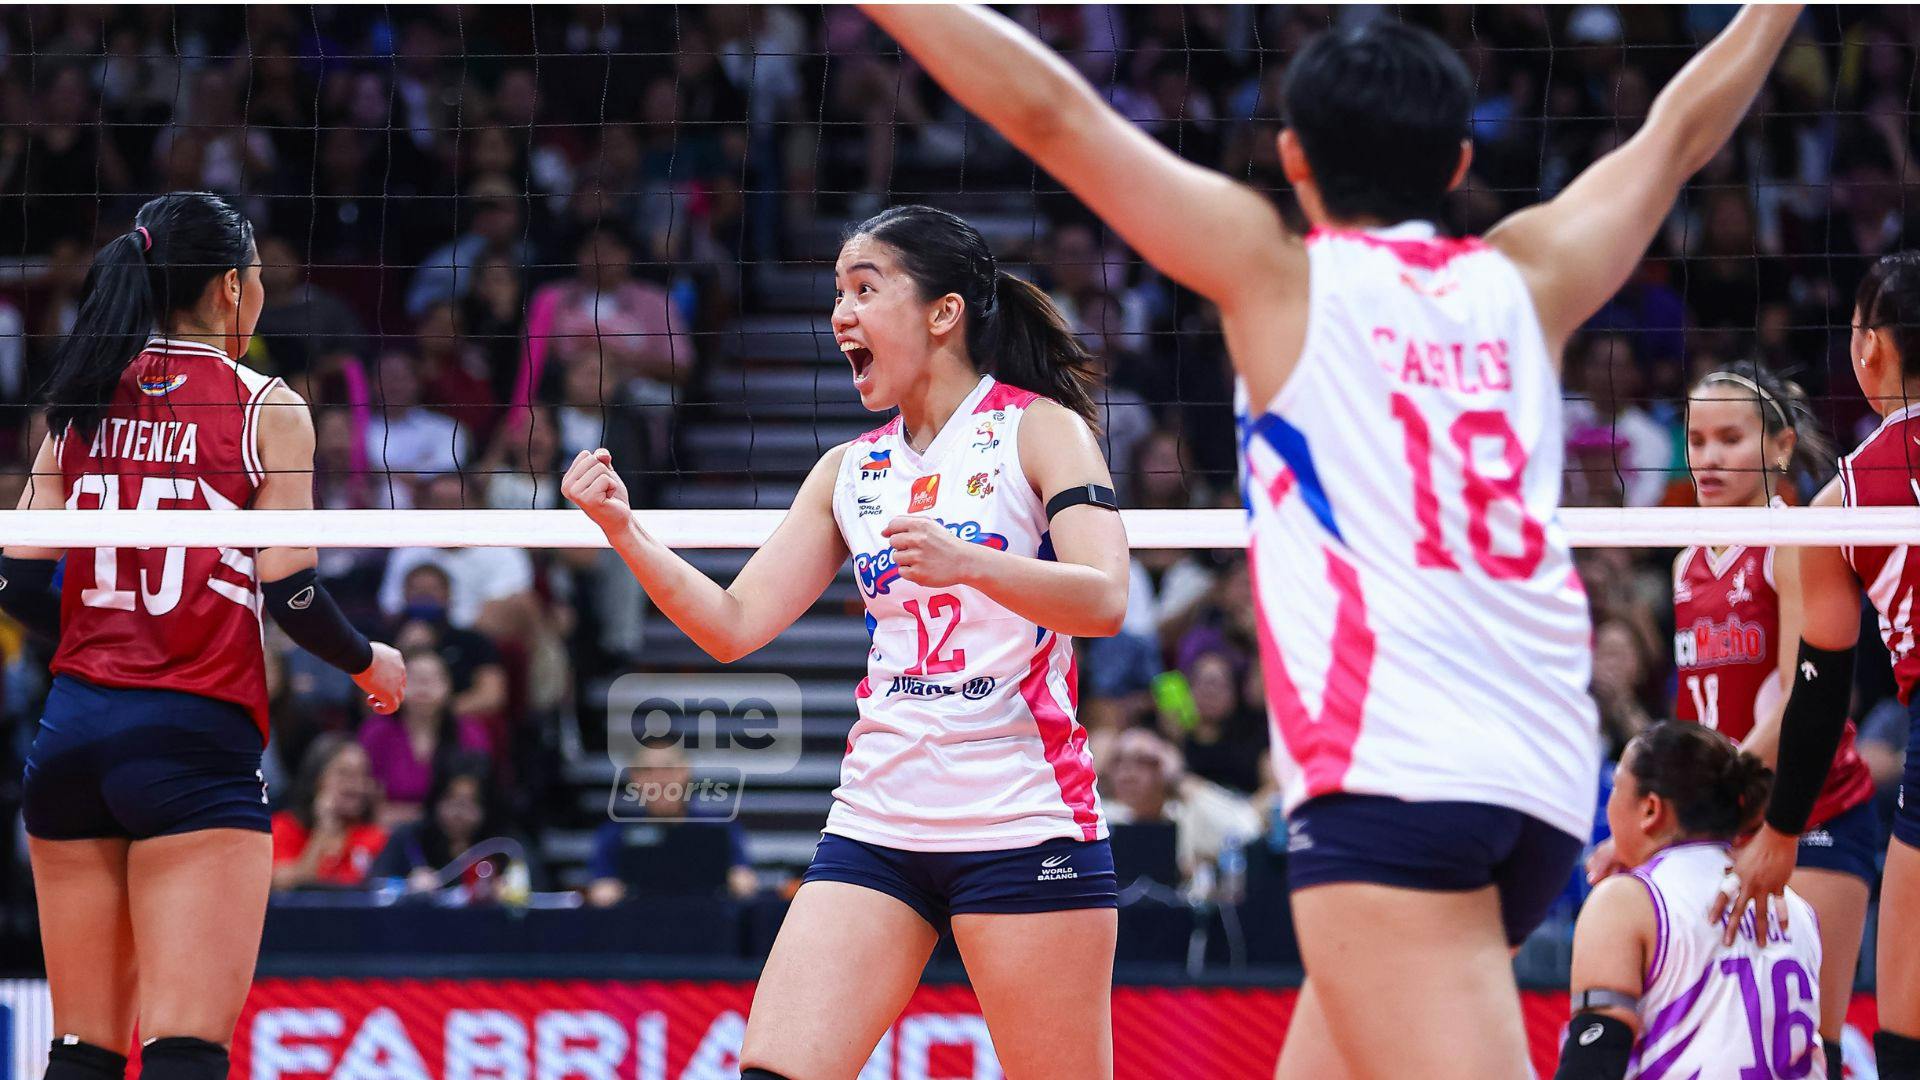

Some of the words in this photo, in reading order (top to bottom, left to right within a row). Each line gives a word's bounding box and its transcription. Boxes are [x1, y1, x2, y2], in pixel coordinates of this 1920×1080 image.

[89, 417, 198, 465] ATIENZA
[861, 469, 887, 481] PHI
[1390, 392, 1546, 581] 18
[65, 472, 198, 616] 15
[903, 593, 965, 675] 12
[886, 676, 955, 697] Allianz
[1037, 872, 1079, 881] BALANCE
[1041, 867, 1073, 876] WORLD
[1720, 957, 1814, 1080] 16
